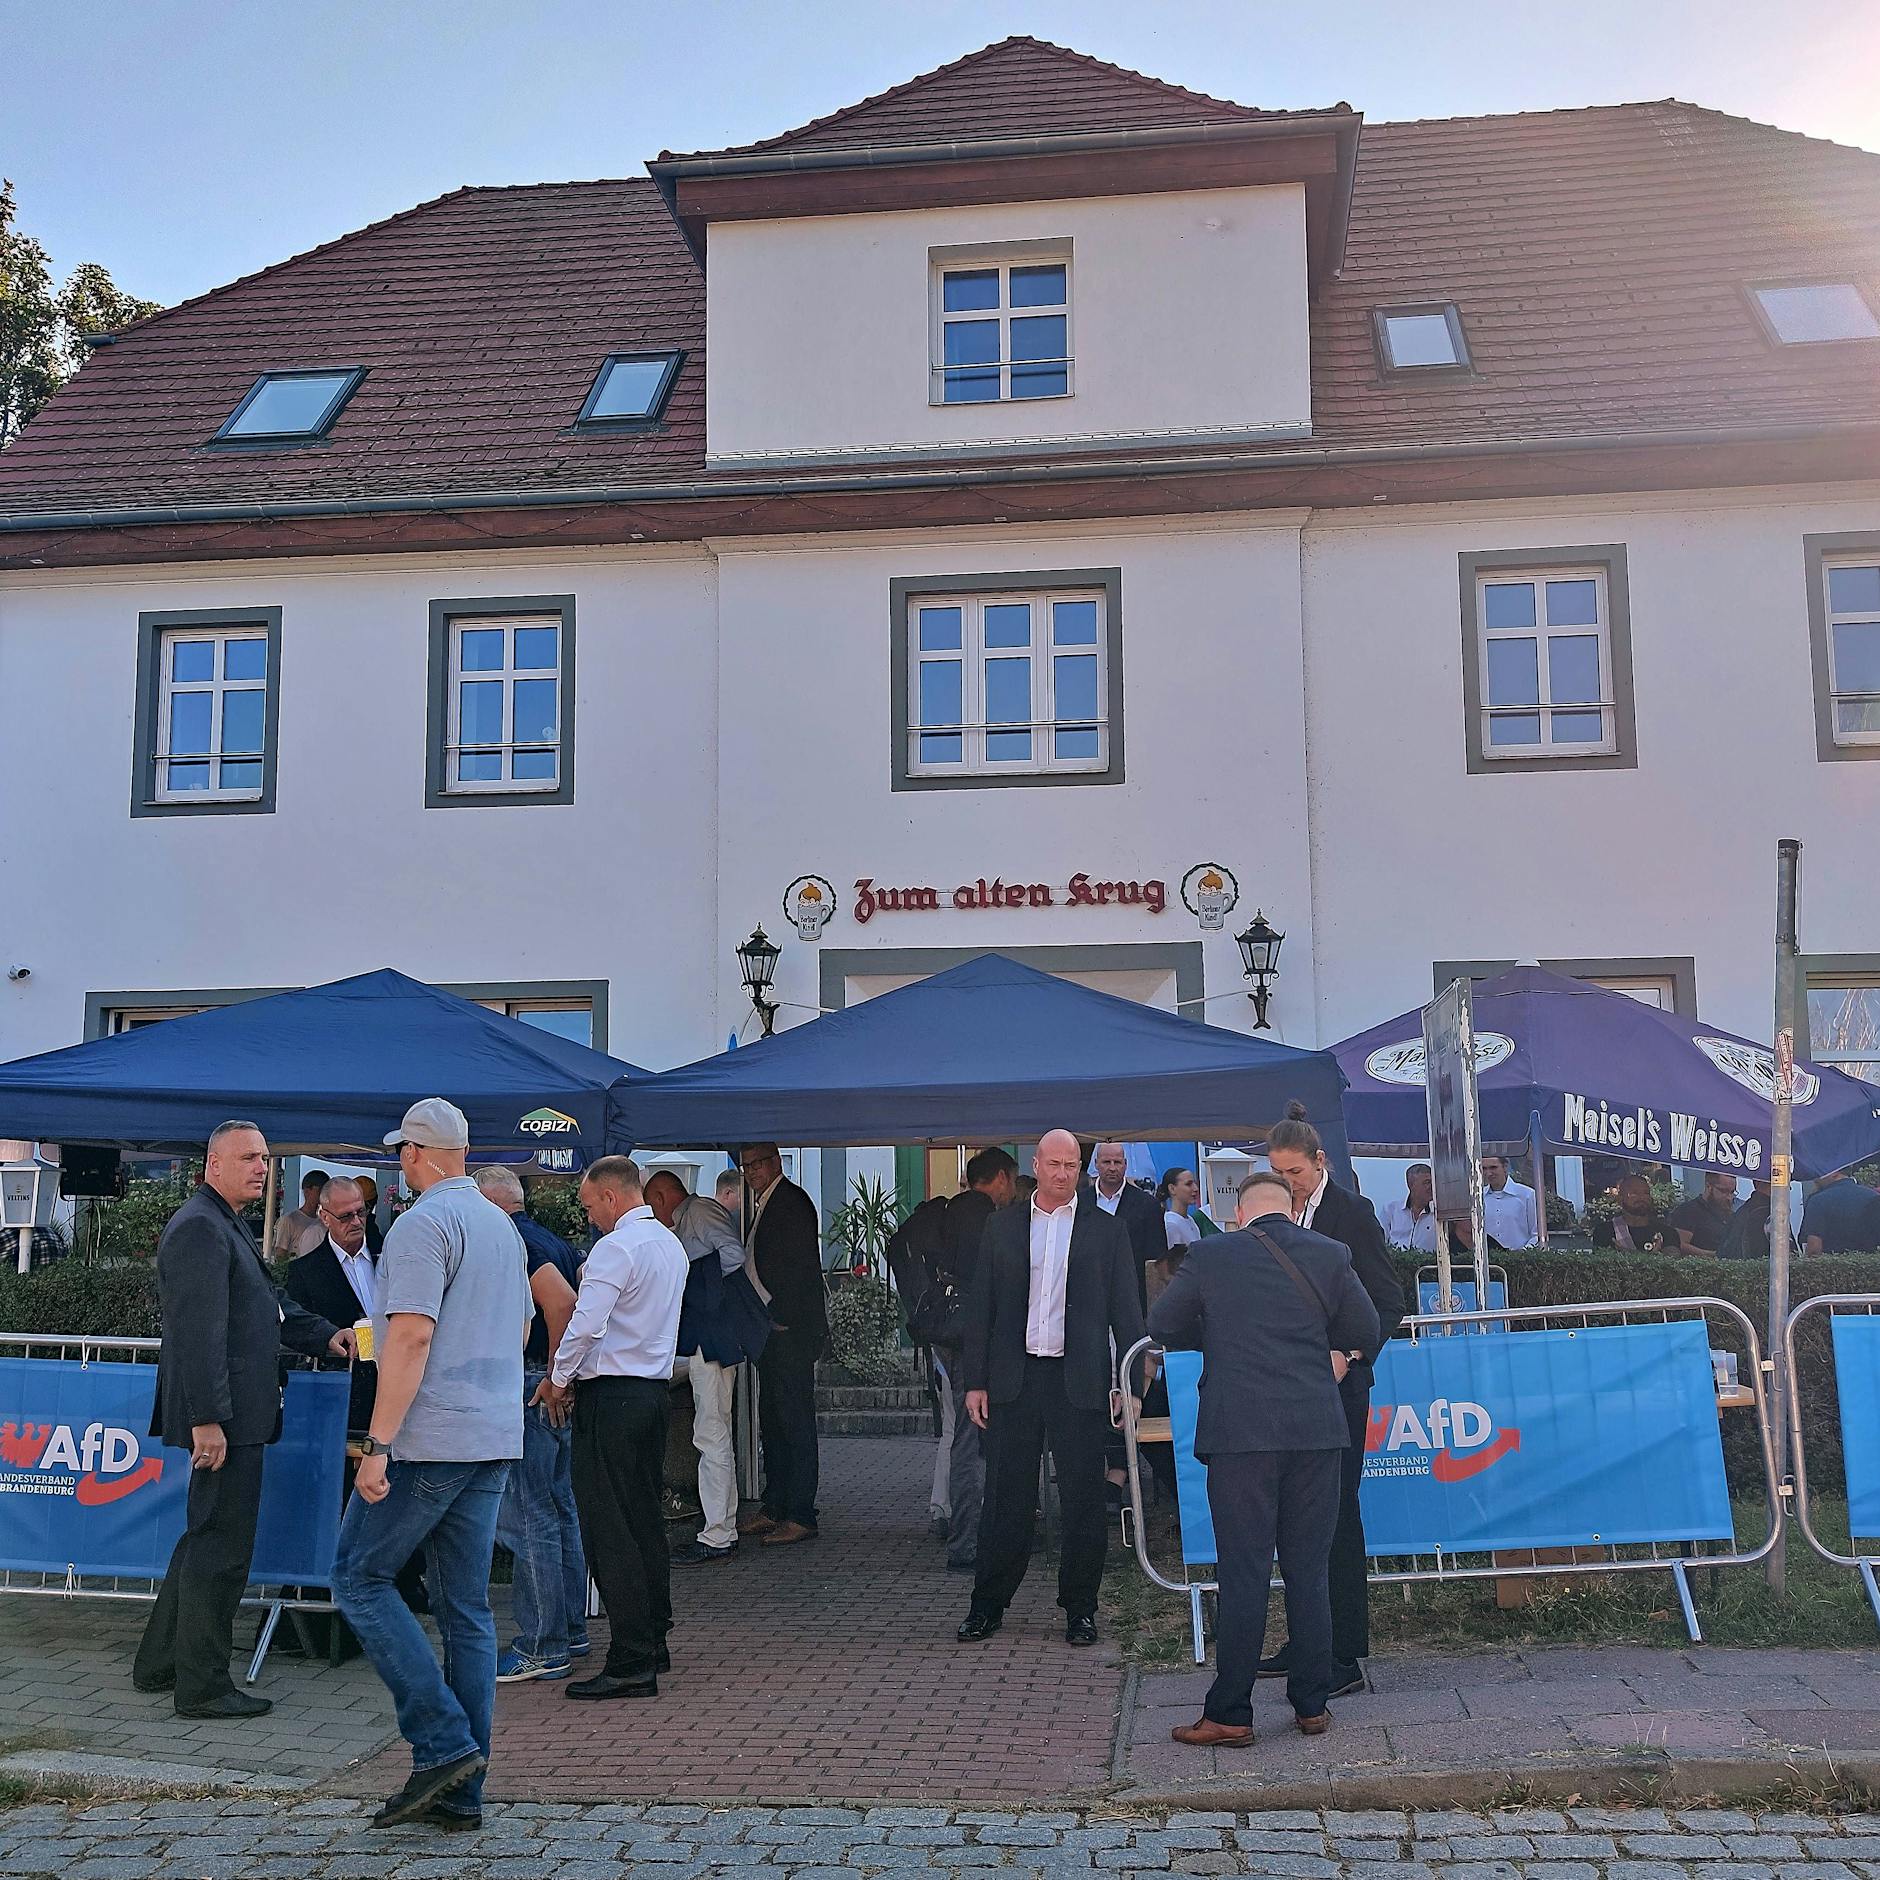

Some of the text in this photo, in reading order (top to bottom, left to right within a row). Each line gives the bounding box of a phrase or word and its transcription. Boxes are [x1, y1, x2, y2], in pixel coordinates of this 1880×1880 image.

[853, 872, 1167, 924] Zum alten Krug
[519, 1120, 571, 1133] COBIZI
[1562, 1092, 1662, 1154] Maisel's
[1668, 1111, 1763, 1171] Weisse
[38, 1421, 140, 1474] AfD
[1387, 1398, 1492, 1452] AfD
[0, 1483, 75, 1496] BRANDENBURG
[1361, 1466, 1430, 1478] ANDENBURG
